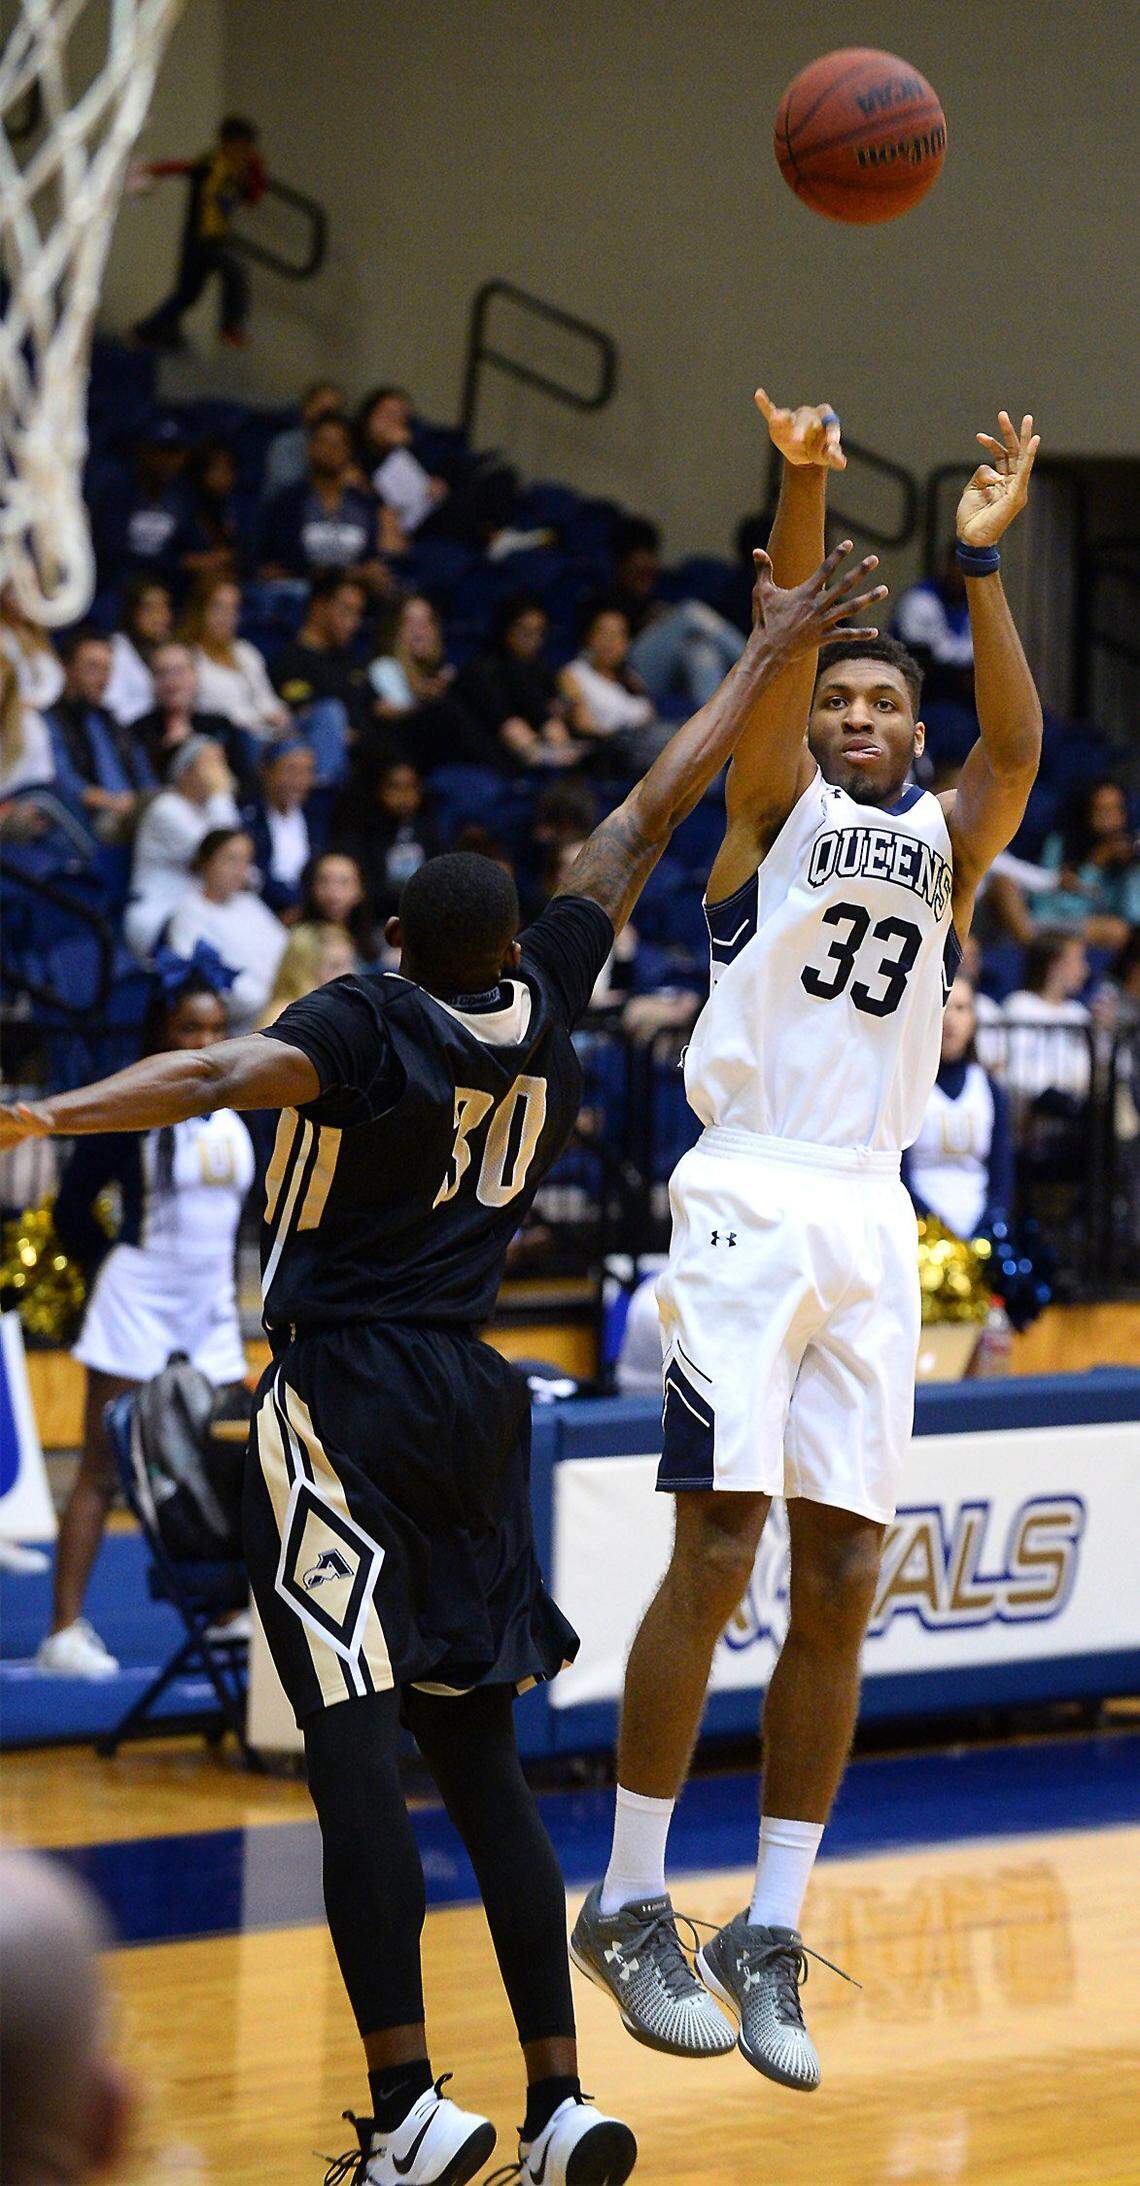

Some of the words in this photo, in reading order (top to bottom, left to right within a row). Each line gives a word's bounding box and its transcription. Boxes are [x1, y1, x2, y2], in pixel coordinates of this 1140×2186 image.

[808, 827, 953, 922] QUEENS
[801, 902, 923, 1017] 33
[433, 1074, 547, 1208] 30
